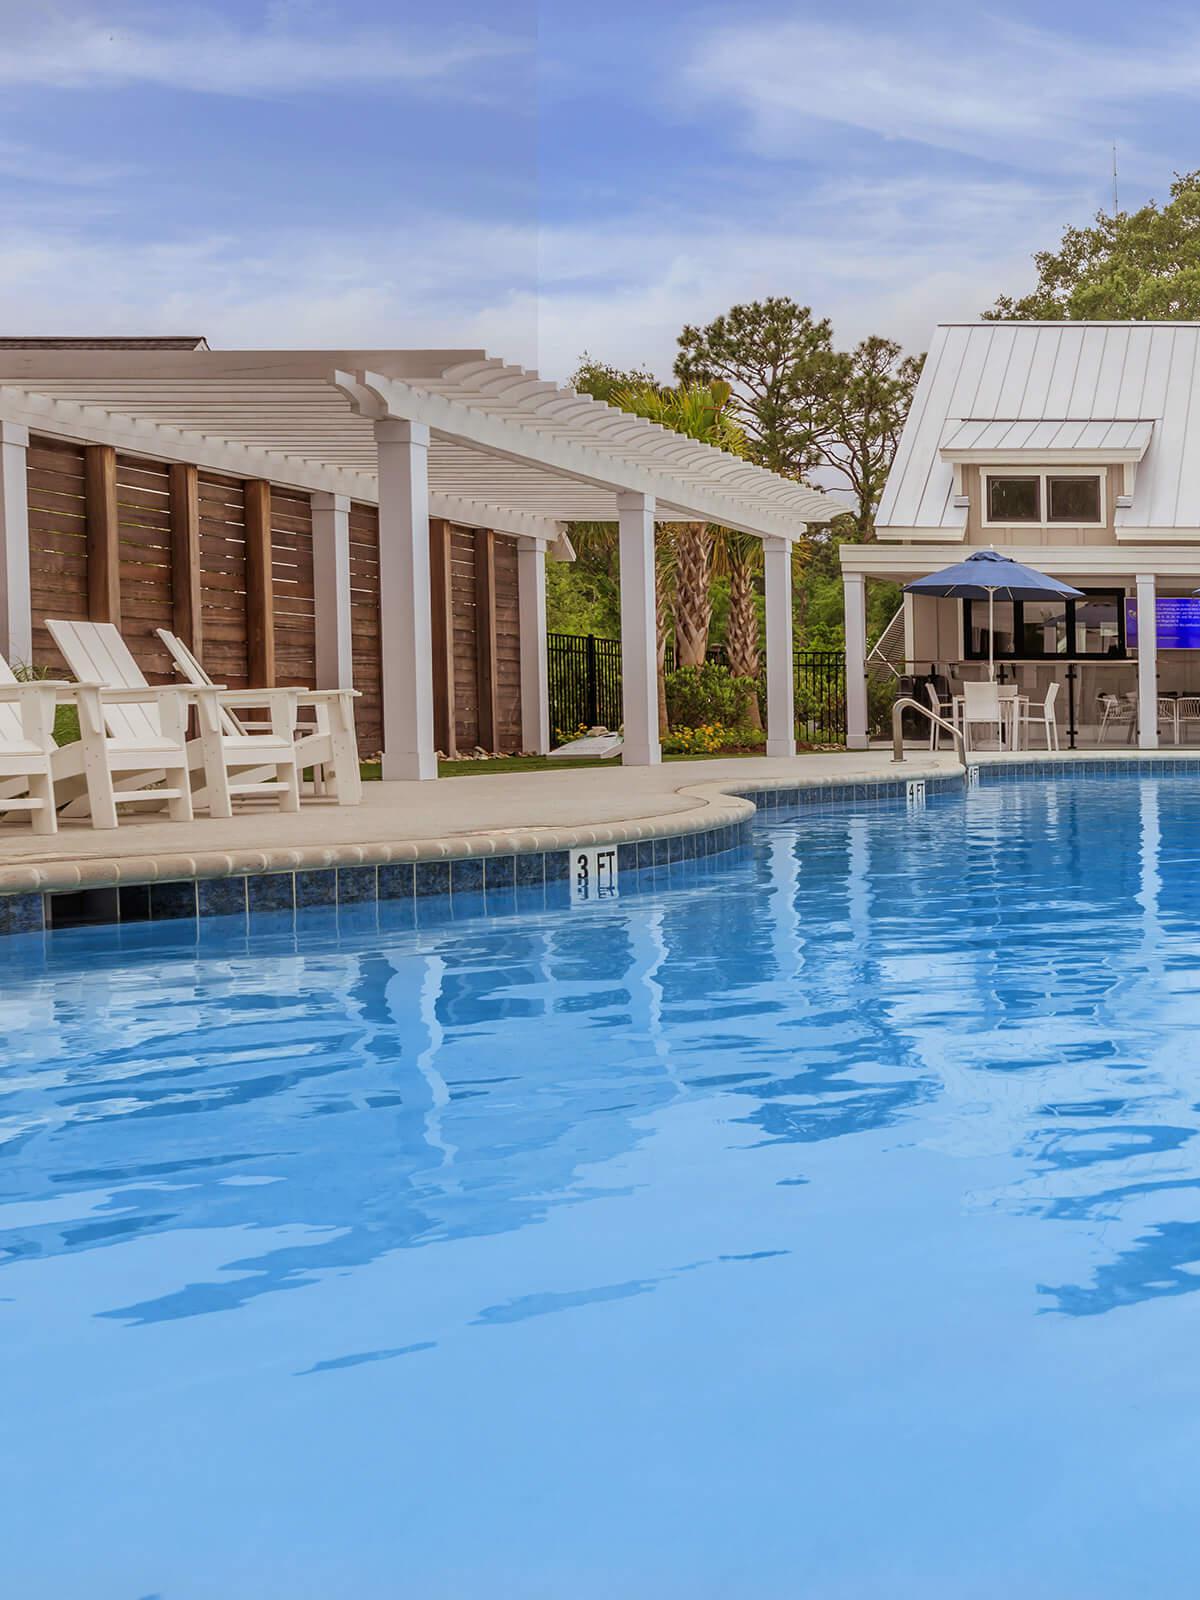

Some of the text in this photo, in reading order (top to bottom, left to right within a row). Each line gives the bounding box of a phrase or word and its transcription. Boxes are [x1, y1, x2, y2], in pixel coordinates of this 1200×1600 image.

[909, 783, 924, 799] 4 FT
[578, 851, 615, 879] 3 FT
